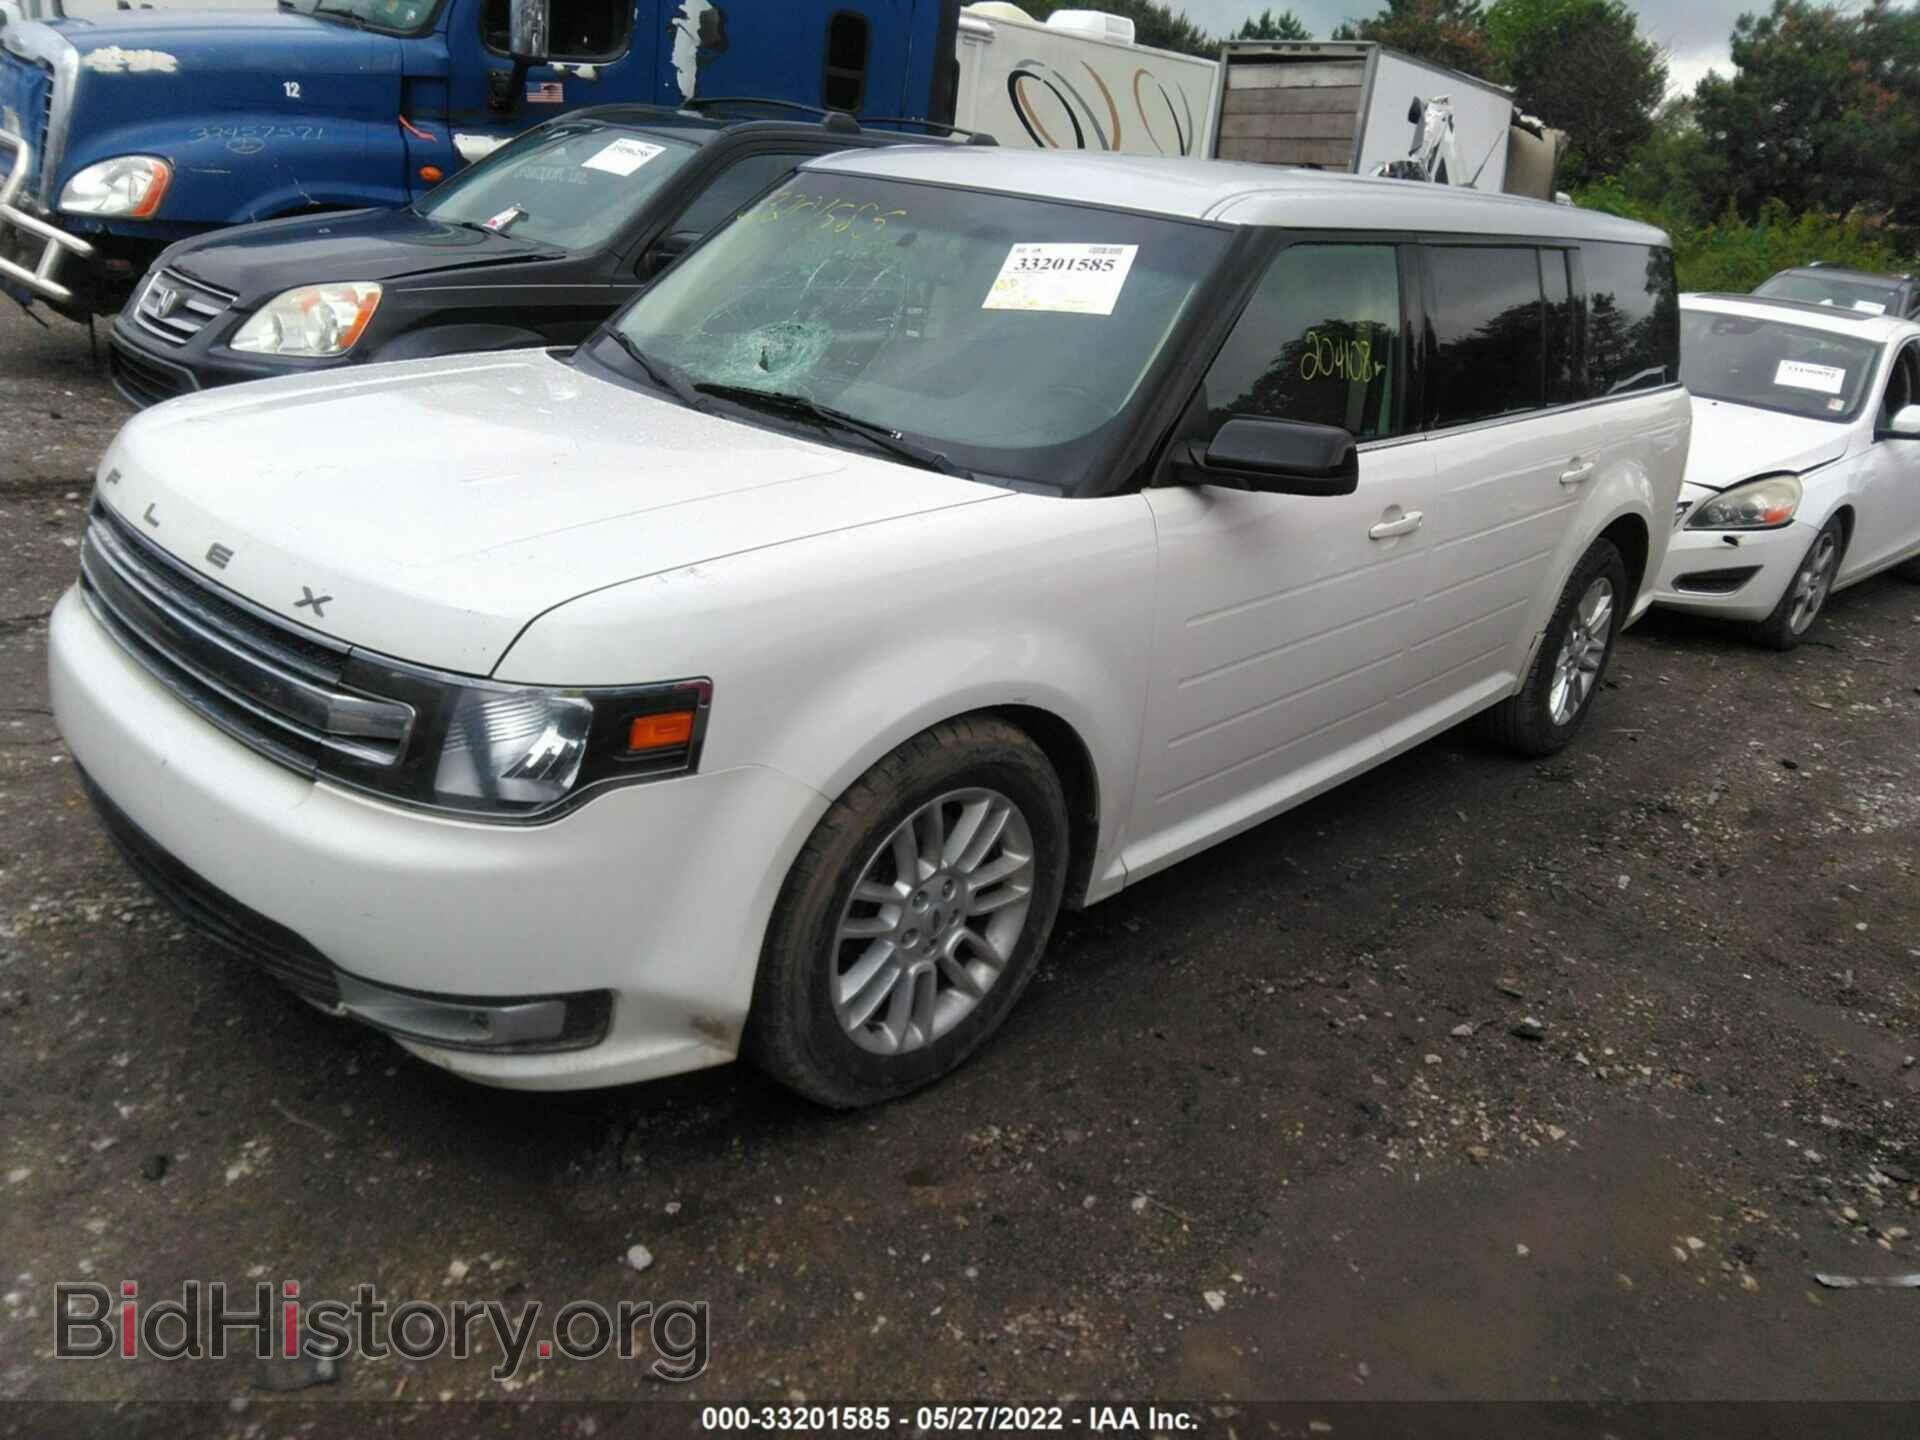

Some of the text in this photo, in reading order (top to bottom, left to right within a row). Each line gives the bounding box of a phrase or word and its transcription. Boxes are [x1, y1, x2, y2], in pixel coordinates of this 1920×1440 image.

[283, 80, 300, 98] 12
[1014, 257, 1117, 272] 33201585
[105, 467, 334, 617] FLEX
